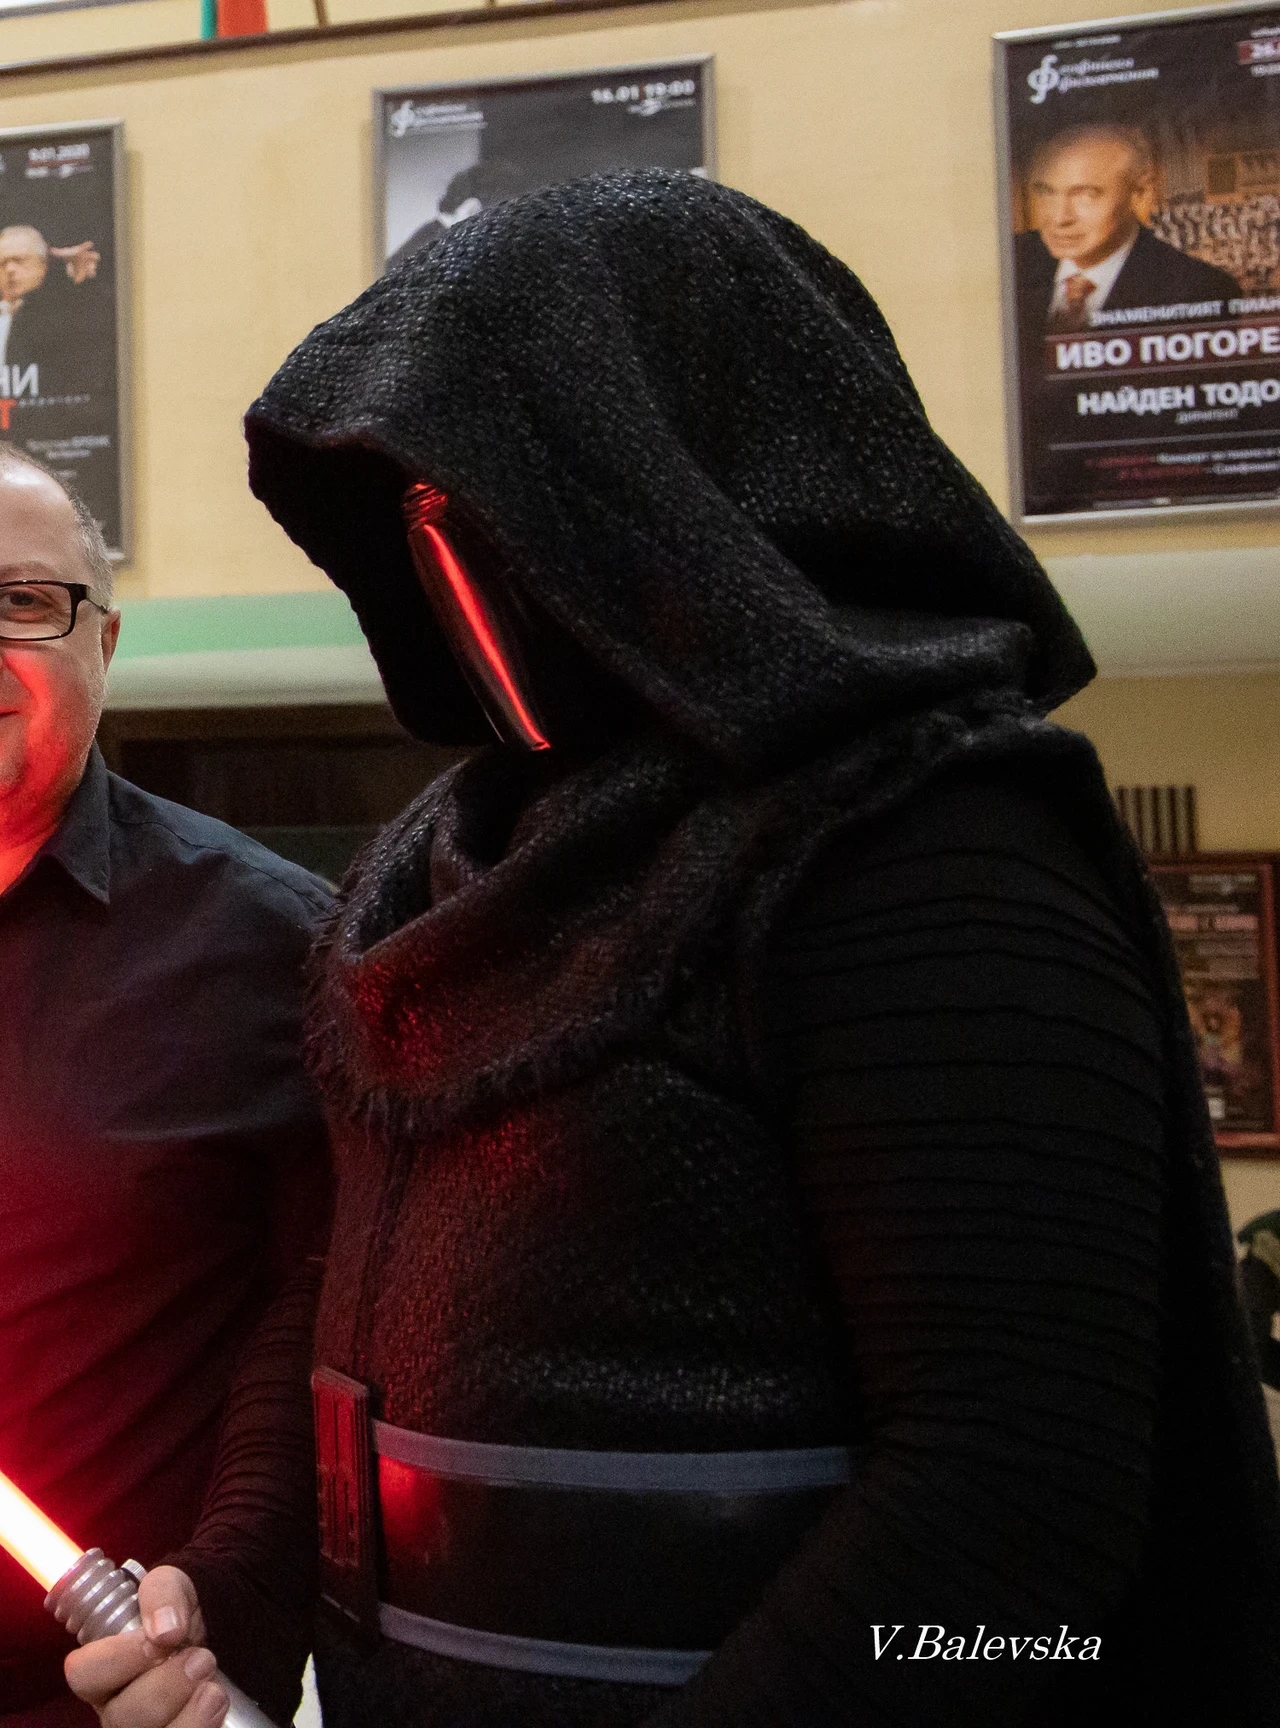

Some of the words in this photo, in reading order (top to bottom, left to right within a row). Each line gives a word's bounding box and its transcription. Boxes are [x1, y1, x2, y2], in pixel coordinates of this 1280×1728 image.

[1055, 339, 1133, 370] ИВО
[1139, 326, 1280, 363] ПОГОРЕ
[1077, 385, 1196, 416] НАЙДЕН
[1201, 379, 1280, 408] ТОДО
